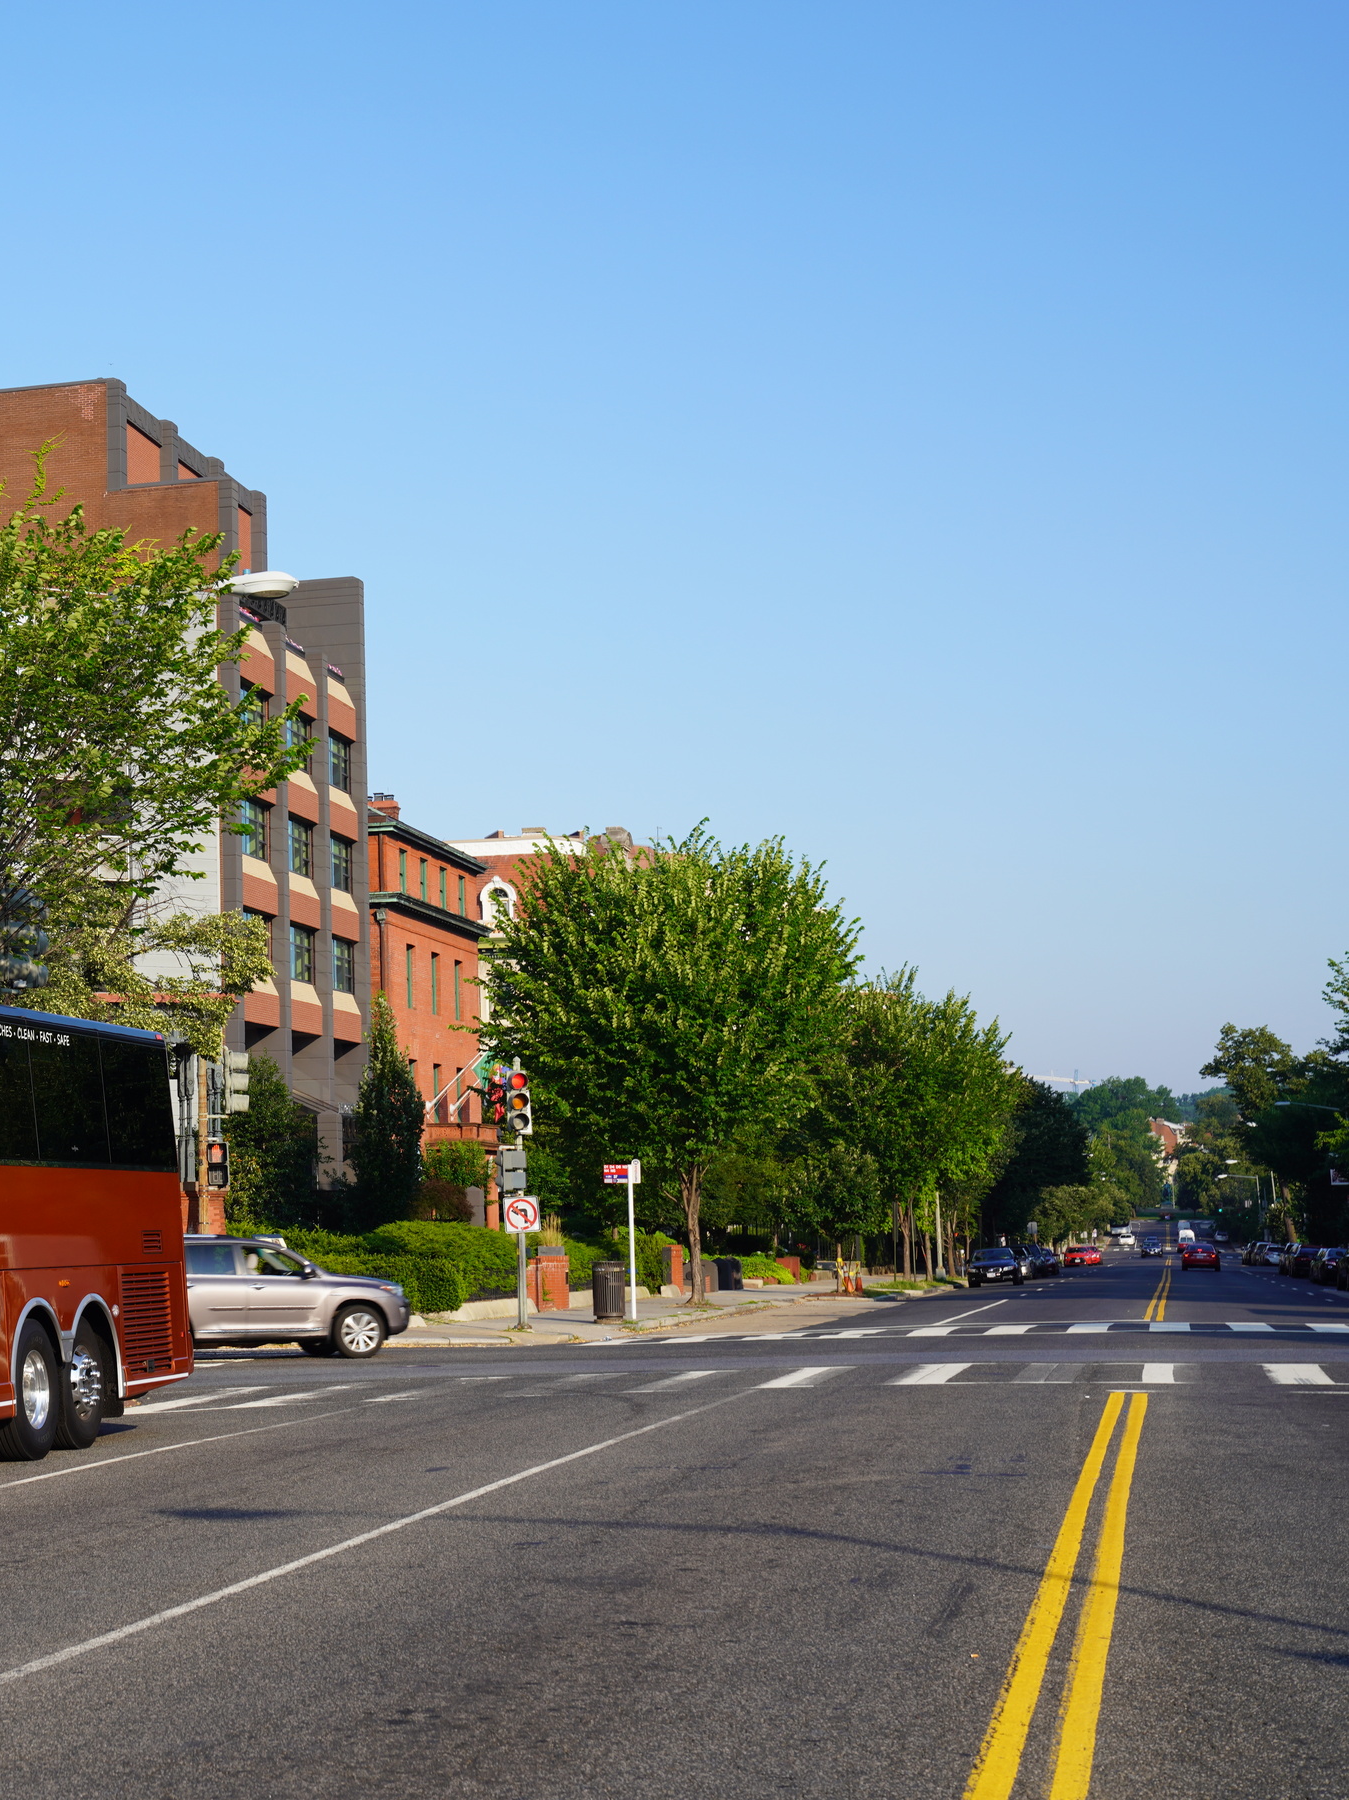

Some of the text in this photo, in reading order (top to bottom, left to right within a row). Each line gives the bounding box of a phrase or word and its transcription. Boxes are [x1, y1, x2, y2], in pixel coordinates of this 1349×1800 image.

[17, 1026, 35, 1041] CLEAN
[39, 1030, 53, 1044] FAST
[57, 1035, 71, 1047] SAFE
